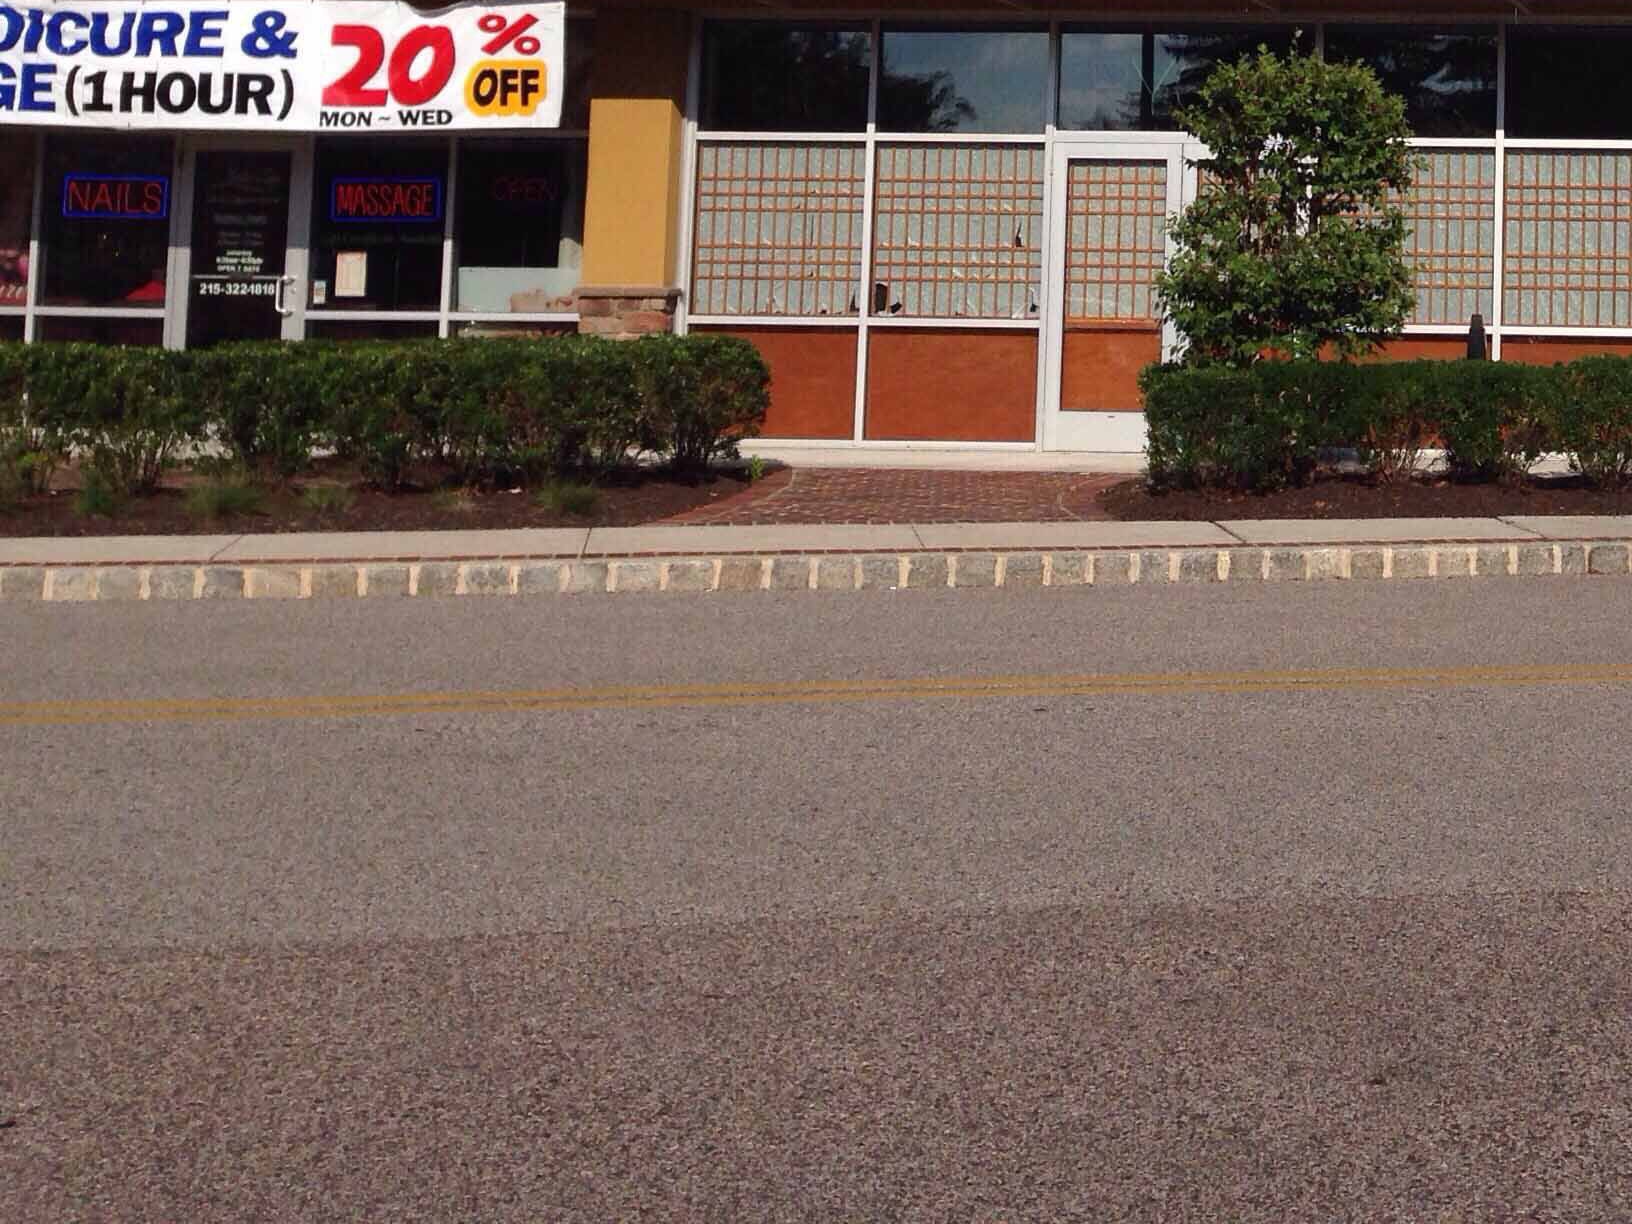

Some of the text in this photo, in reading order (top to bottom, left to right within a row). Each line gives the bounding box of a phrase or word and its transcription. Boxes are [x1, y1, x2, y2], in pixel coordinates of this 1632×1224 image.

[241, 10, 299, 59] &
[473, 68, 540, 108] OFF
[319, 110, 373, 127] MON
[398, 109, 454, 126] WED
[68, 181, 162, 213] NAILS
[336, 183, 433, 216] MASSAGE
